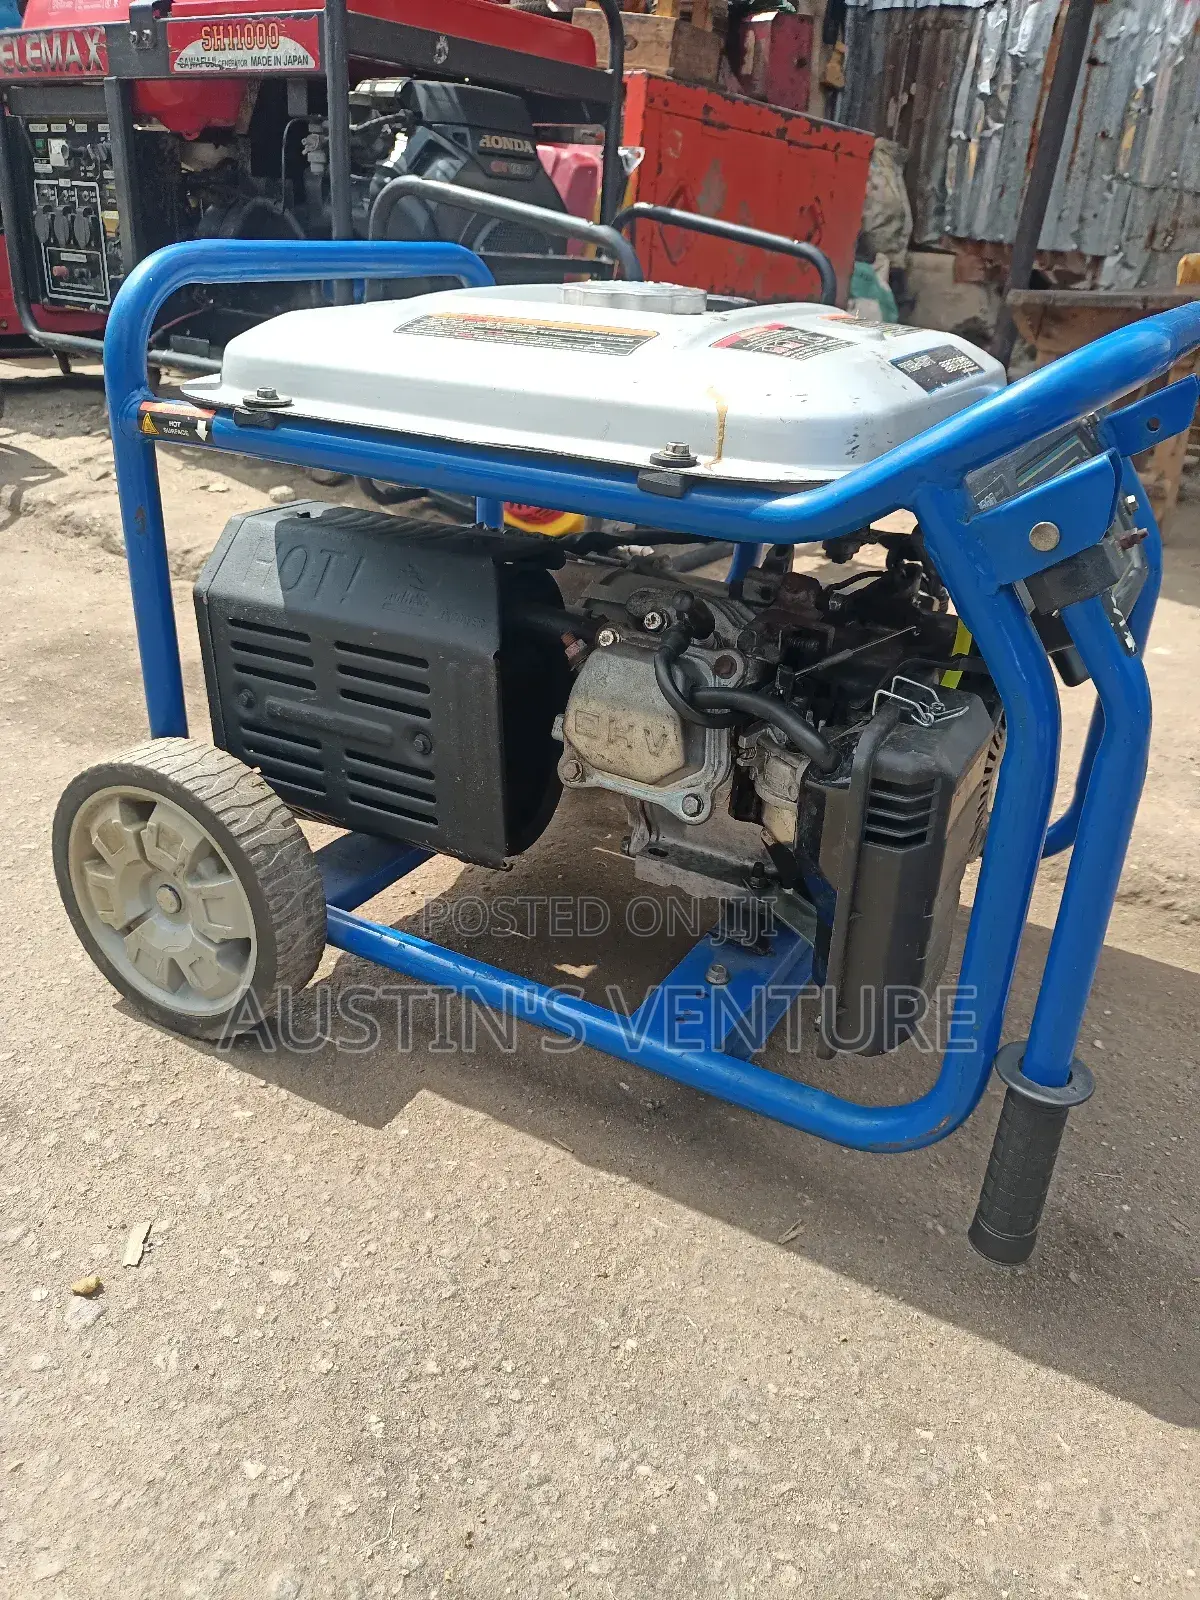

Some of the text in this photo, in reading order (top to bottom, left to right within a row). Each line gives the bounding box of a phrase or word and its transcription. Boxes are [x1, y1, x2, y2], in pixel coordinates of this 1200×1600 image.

[201, 22, 280, 51] SH11000
[0, 31, 104, 73] ELEMAX
[250, 56, 272, 67] MADE
[273, 56, 281, 66] IN
[283, 55, 309, 66] JAPAN
[479, 134, 535, 153] HONDA
[163, 427, 189, 436] SURFACE
[168, 420, 181, 428] HOT
